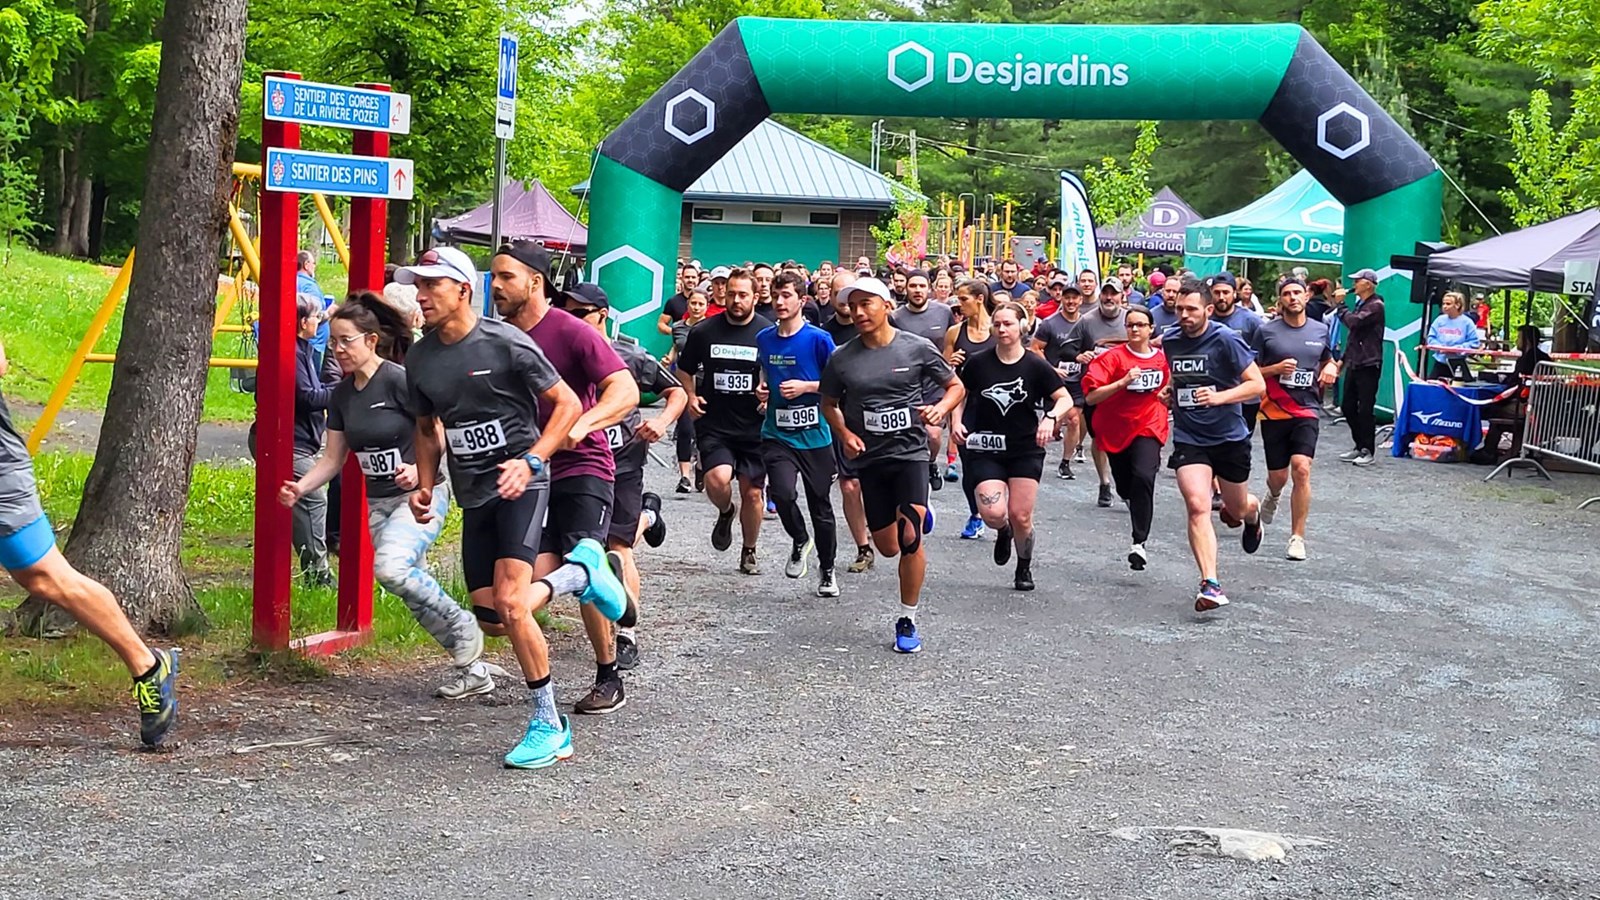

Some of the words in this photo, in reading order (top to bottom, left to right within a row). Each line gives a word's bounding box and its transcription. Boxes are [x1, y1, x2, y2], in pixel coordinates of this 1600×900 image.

[947, 52, 1129, 92] Desjardins
[294, 87, 327, 104] SENTIER
[329, 92, 346, 106] DES
[348, 94, 380, 110] GORGES
[293, 102, 306, 116] DE
[307, 104, 318, 118] LA
[353, 110, 379, 124] POZER
[291, 162, 330, 182] SENTIER
[331, 167, 351, 184] DES
[353, 168, 378, 186] PINS
[1152, 207, 1180, 226] D
[1309, 238, 1344, 257] Desj
[1571, 281, 1594, 293] STA
[1172, 360, 1204, 372] RCM
[727, 375, 749, 389] 935
[1142, 373, 1160, 387] 974
[1294, 372, 1312, 385] 852
[792, 408, 815, 425] 996
[881, 411, 907, 430] 989
[463, 424, 499, 451] 988
[981, 435, 1003, 449] 940
[369, 451, 395, 473] 987
